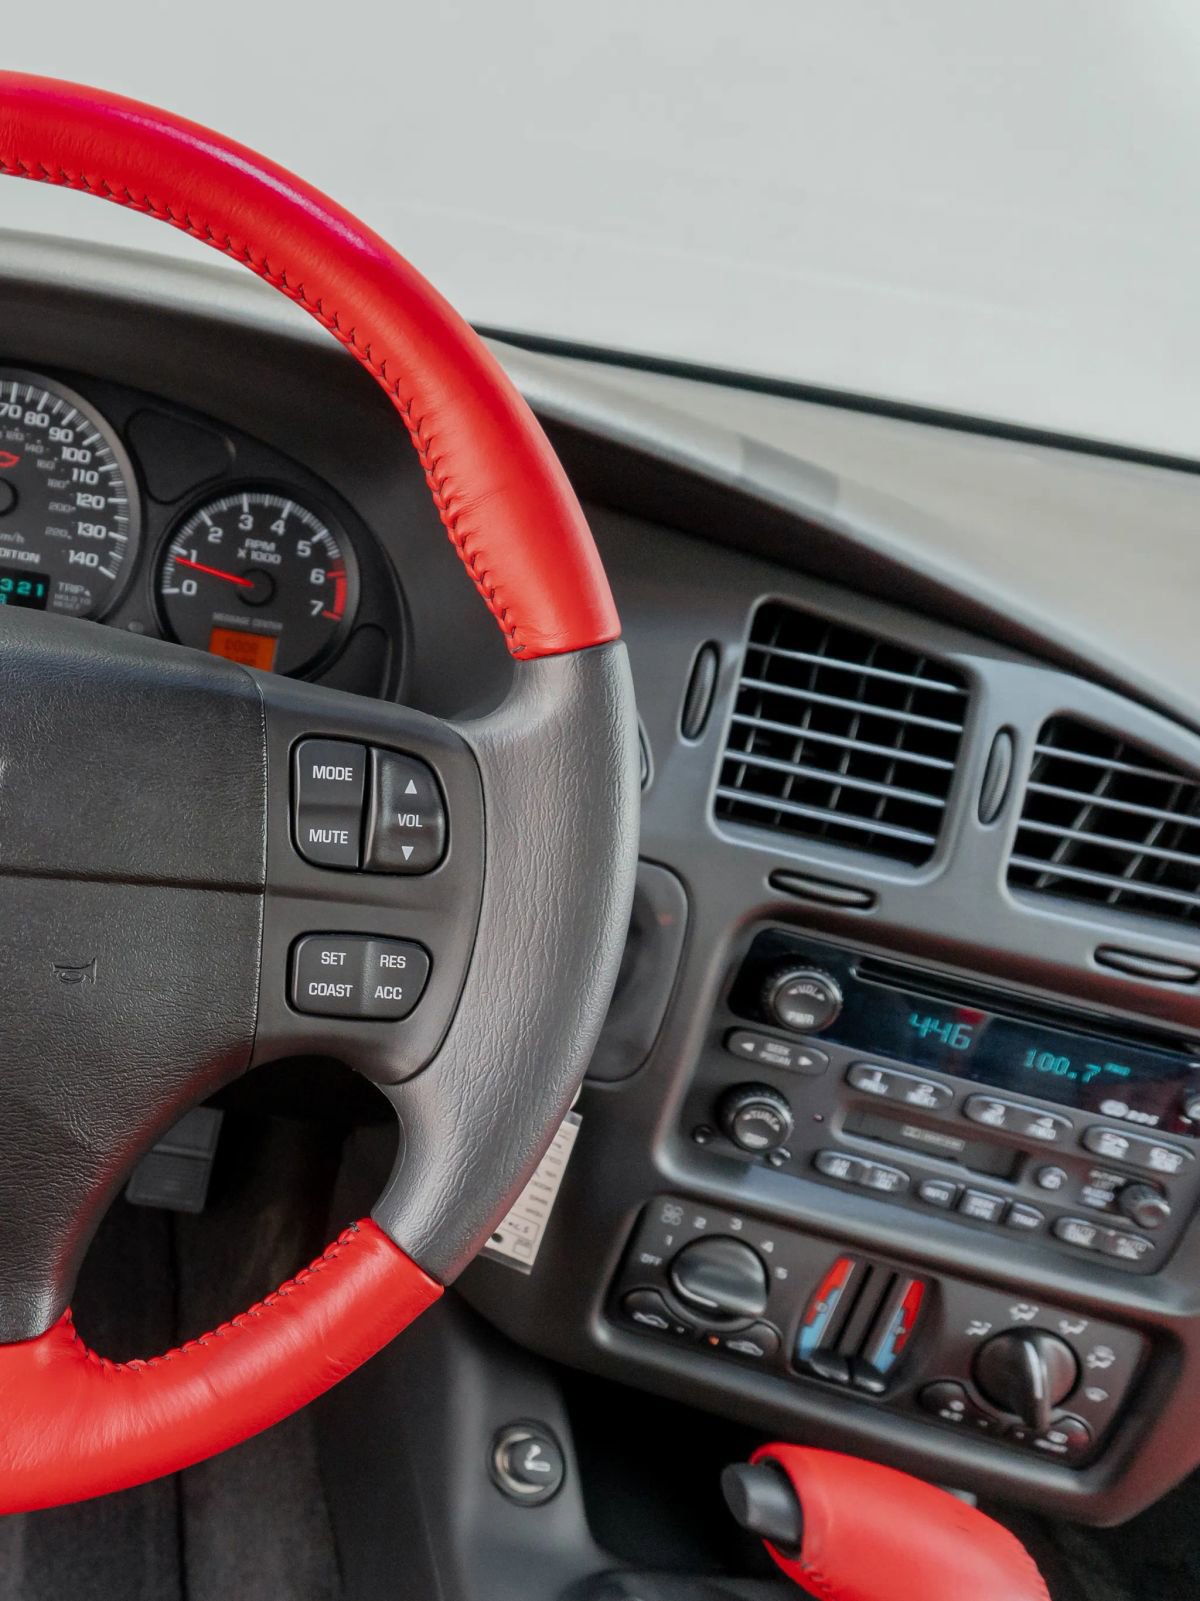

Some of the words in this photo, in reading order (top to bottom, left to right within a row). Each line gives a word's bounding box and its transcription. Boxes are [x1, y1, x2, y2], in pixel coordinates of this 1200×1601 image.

[0, 403, 22, 419] 70
[24, 411, 49, 427] 80
[49, 427, 74, 443] 90
[61, 446, 91, 464] 100
[72, 467, 99, 485] 110
[76, 492, 105, 510] 120
[77, 521, 106, 539] 130
[238, 515, 253, 530] 3
[270, 520, 285, 535] 4
[208, 527, 223, 543] 2
[245, 539, 276, 552] RPM
[297, 540, 311, 556] 5
[68, 550, 99, 568] 140
[189, 550, 198, 563] 1
[251, 551, 281, 565] 1000
[310, 569, 325, 584] 6
[182, 580, 197, 595] 0
[310, 600, 323, 616] 7
[312, 766, 353, 781] MODE
[398, 813, 423, 828] VOL
[309, 828, 348, 844] MUTE
[321, 952, 346, 966] SET
[380, 954, 406, 969] RES
[308, 982, 353, 998] COAST
[374, 986, 403, 1000] ACC
[693, 1217, 707, 1229] 2
[730, 1217, 743, 1231] 3
